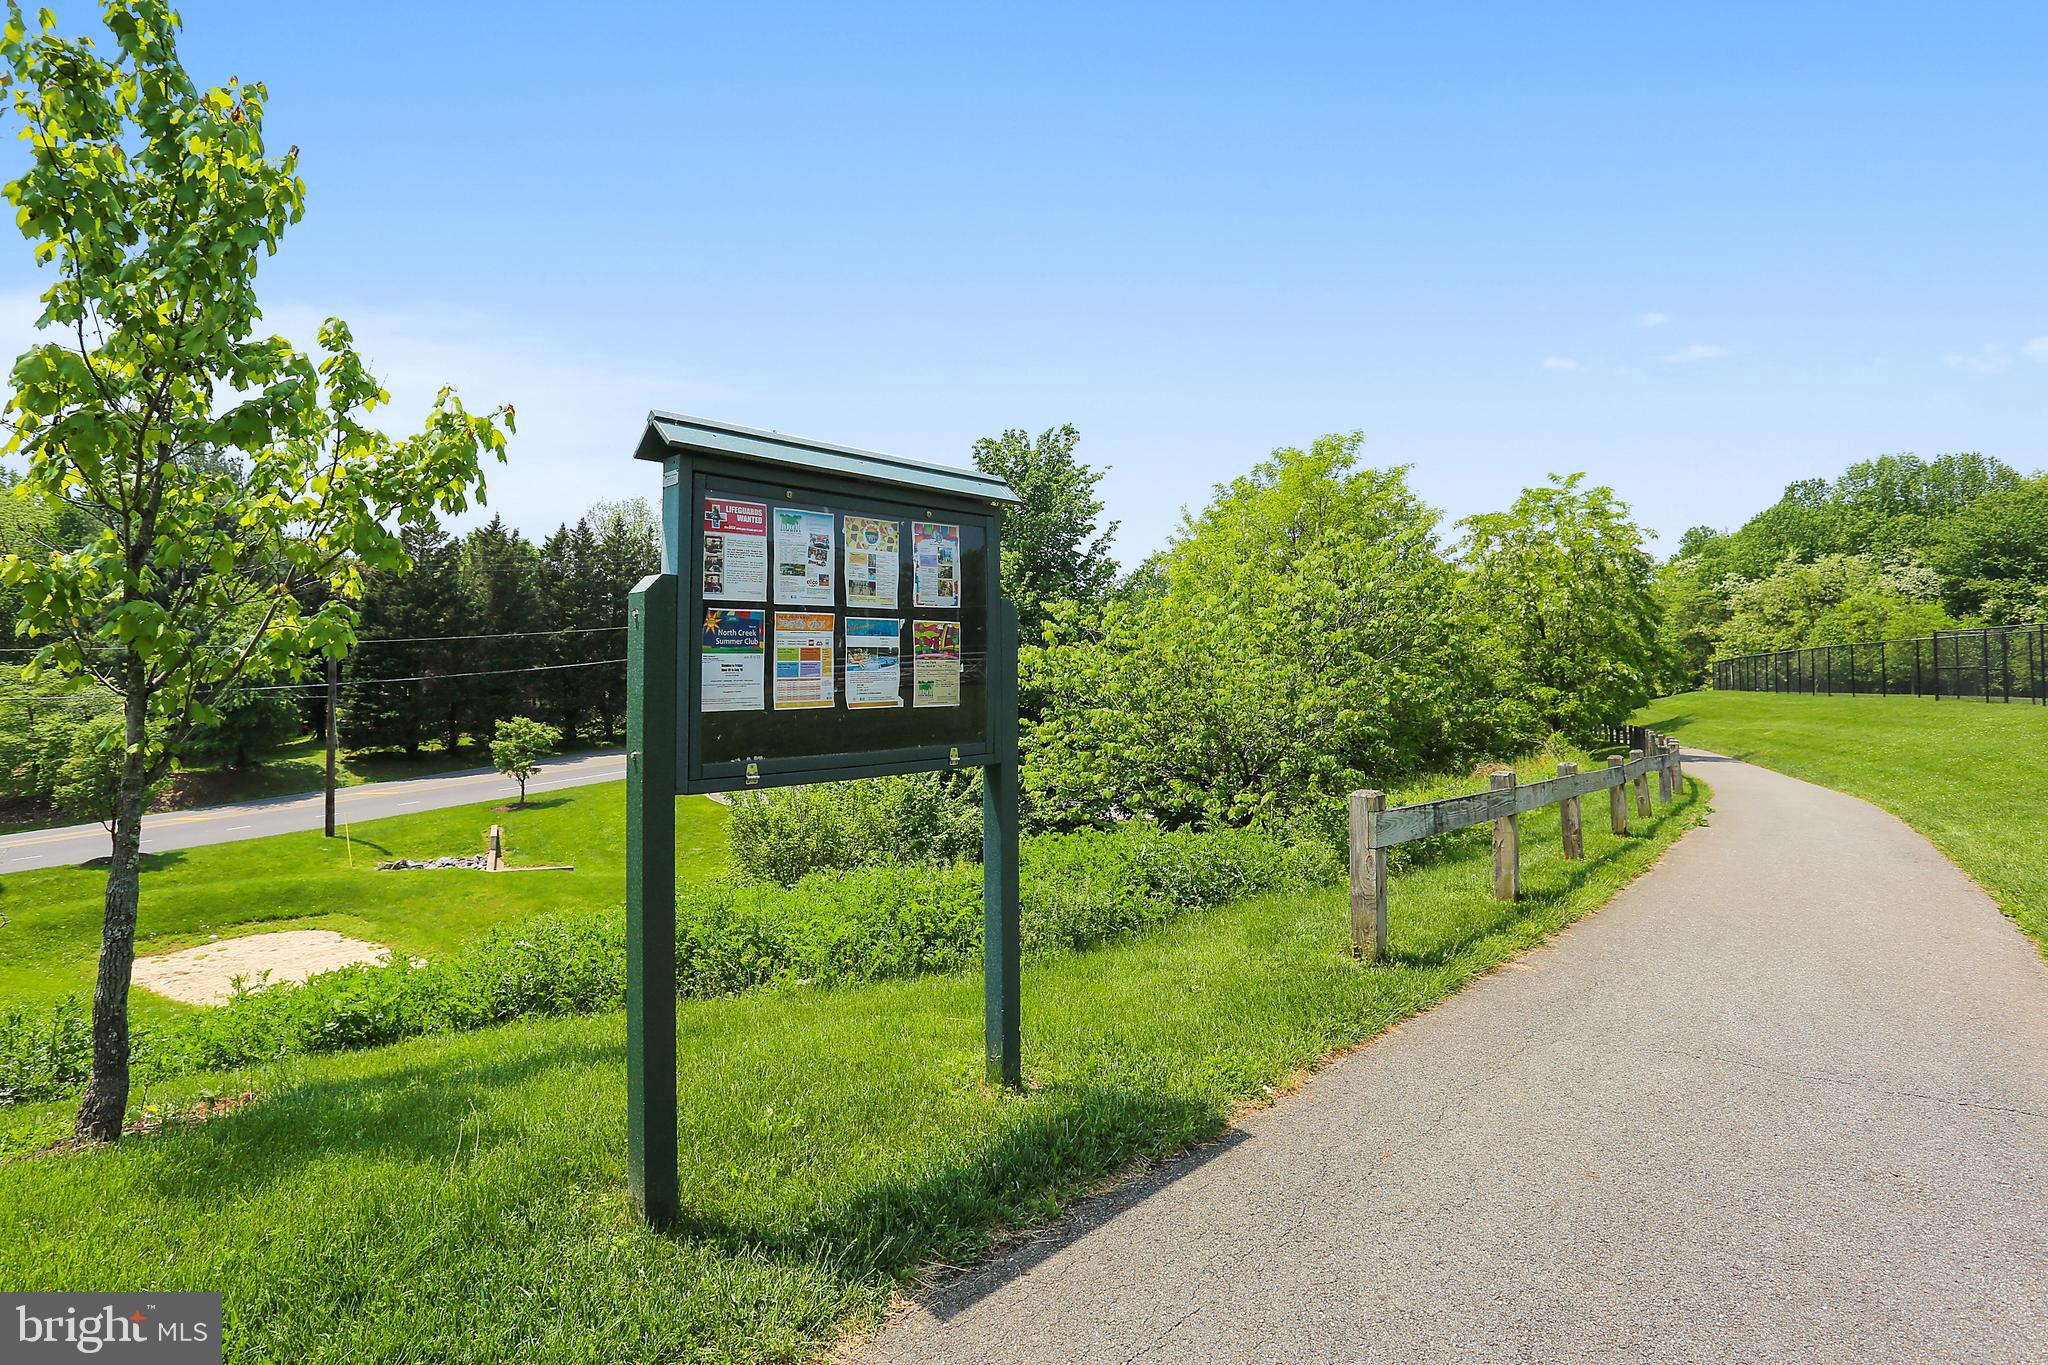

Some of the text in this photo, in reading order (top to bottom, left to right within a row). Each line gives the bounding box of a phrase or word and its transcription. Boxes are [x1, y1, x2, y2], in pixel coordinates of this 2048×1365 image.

[725, 505, 763, 517] LIFEGUARDS
[736, 514, 763, 524] WANTED
[716, 637, 759, 645] Summer Club
